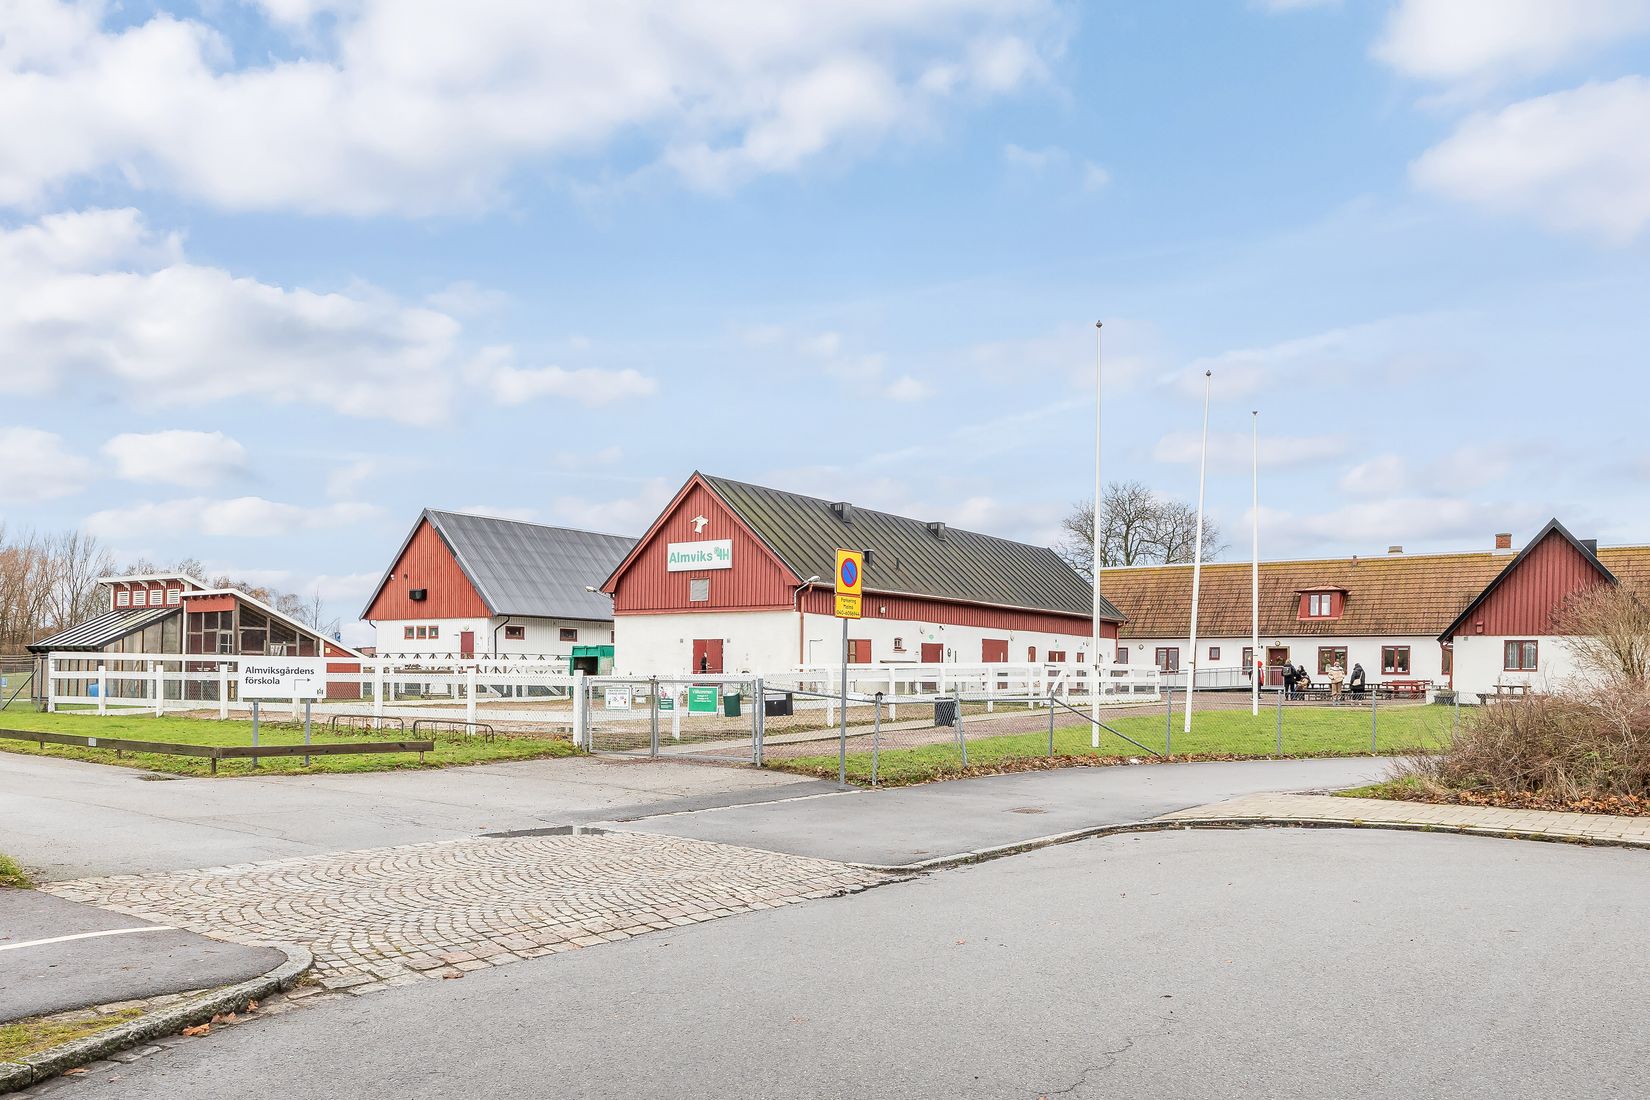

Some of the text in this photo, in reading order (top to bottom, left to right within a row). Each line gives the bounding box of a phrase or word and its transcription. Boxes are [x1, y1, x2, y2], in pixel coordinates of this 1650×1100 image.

[669, 550, 713, 563] Almviks
[245, 666, 315, 676] Almviksgårdens
[245, 677, 280, 685] förskola
